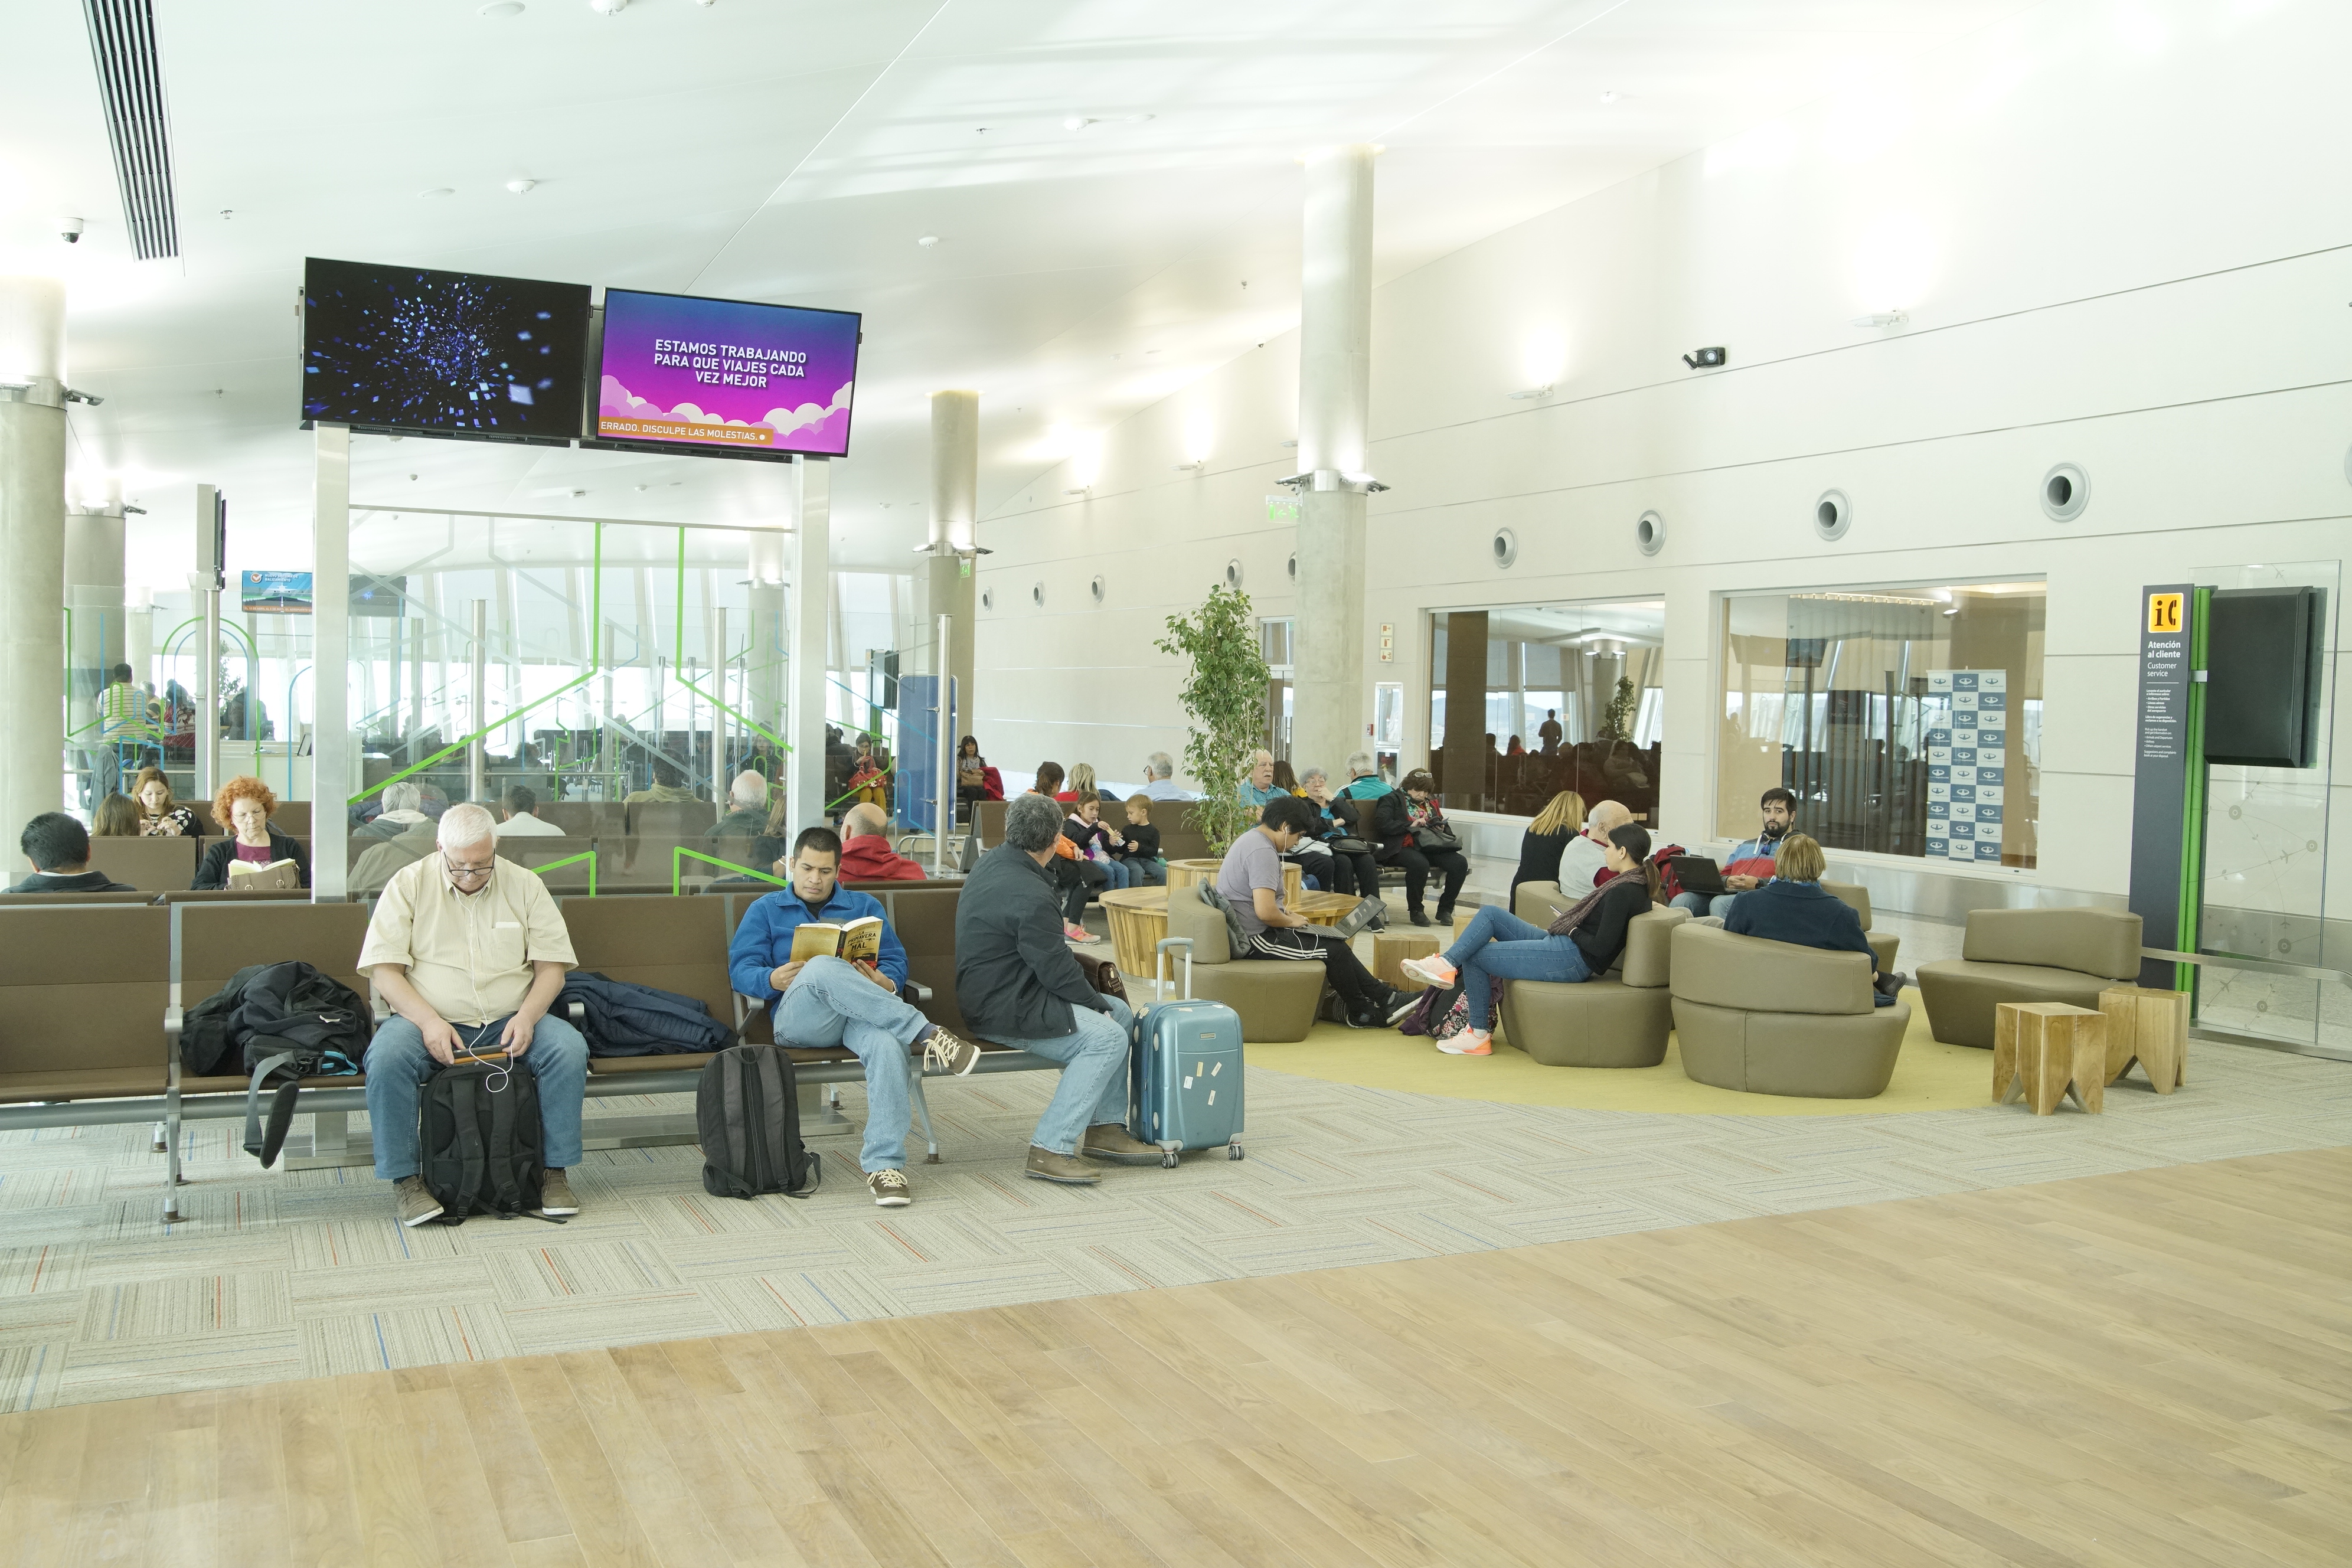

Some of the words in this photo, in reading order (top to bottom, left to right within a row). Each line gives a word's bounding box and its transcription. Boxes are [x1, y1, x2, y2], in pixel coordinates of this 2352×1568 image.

[655, 339, 717, 355] ESTAMOS
[720, 344, 806, 364] TRABAJANDO
[654, 353, 689, 367] PARA
[692, 357, 720, 370] QUE
[723, 359, 767, 374] VIAJES
[770, 364, 805, 377] CADA
[695, 371, 720, 384] VEZ
[723, 373, 767, 388] MEJOR
[600, 422, 640, 432] ERRADO.
[642, 424, 686, 435] DISCULPE
[688, 428, 705, 437] LAS
[707, 429, 757, 441] MOLESTIAS.
[848, 933, 876, 944] PRIMAVERA
[851, 942, 867, 951] MAL
